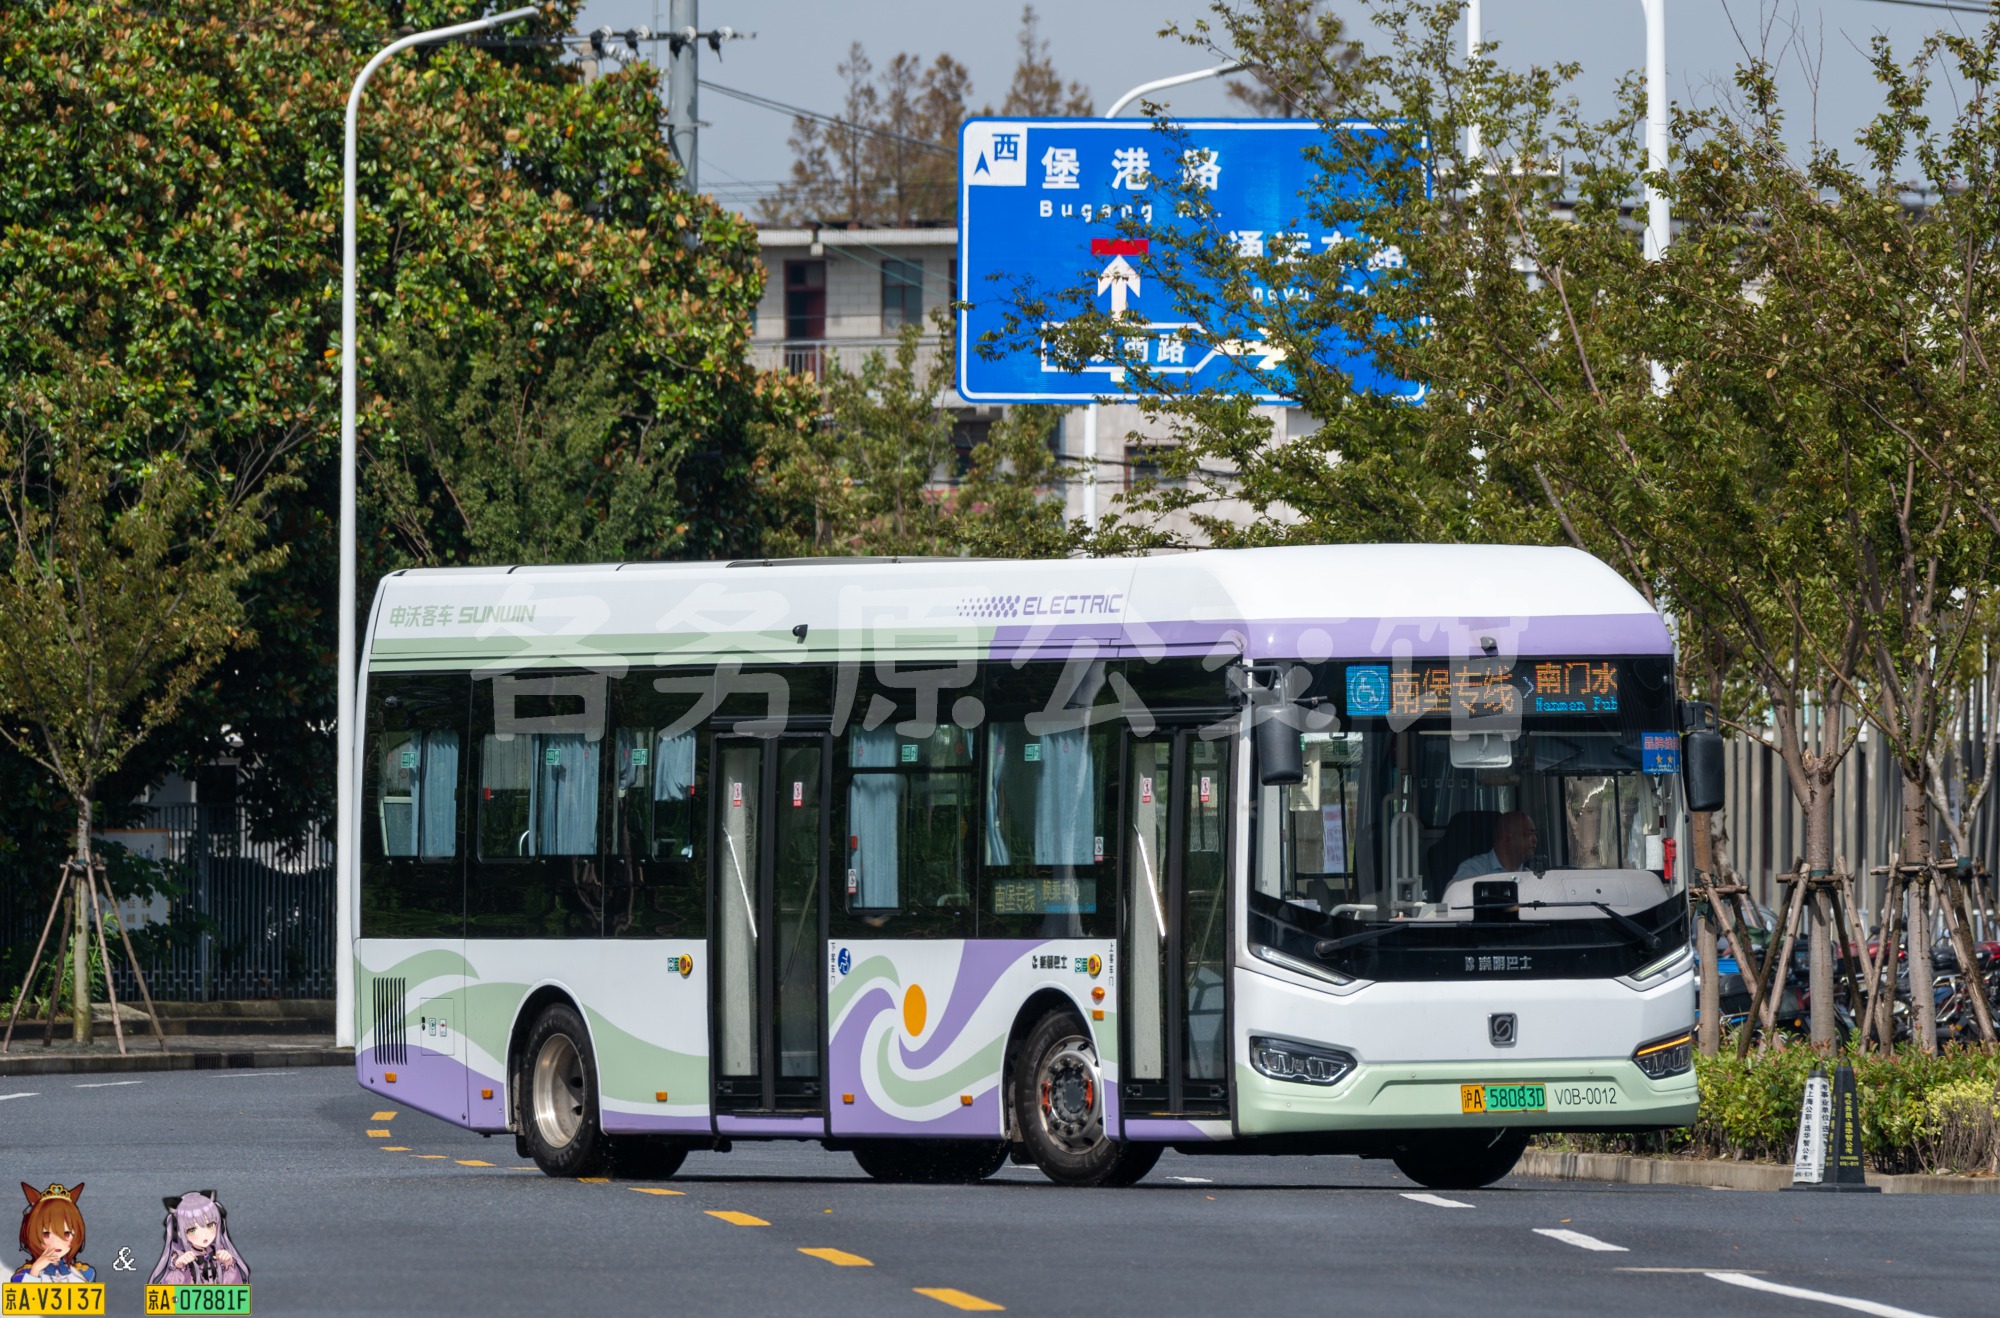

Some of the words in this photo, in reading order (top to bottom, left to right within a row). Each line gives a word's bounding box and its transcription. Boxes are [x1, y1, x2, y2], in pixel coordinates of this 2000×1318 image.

[992, 133, 1021, 162] 西
[1041, 146, 1222, 191] 堡港路
[389, 604, 454, 628] 申沃客车
[458, 605, 537, 624] SUNWIN
[1022, 593, 1124, 615] ELECTRIC
[1390, 665, 1515, 715] 南堡专线
[1535, 662, 1617, 694] 南门水
[1478, 955, 1532, 971] 崇明巴士
